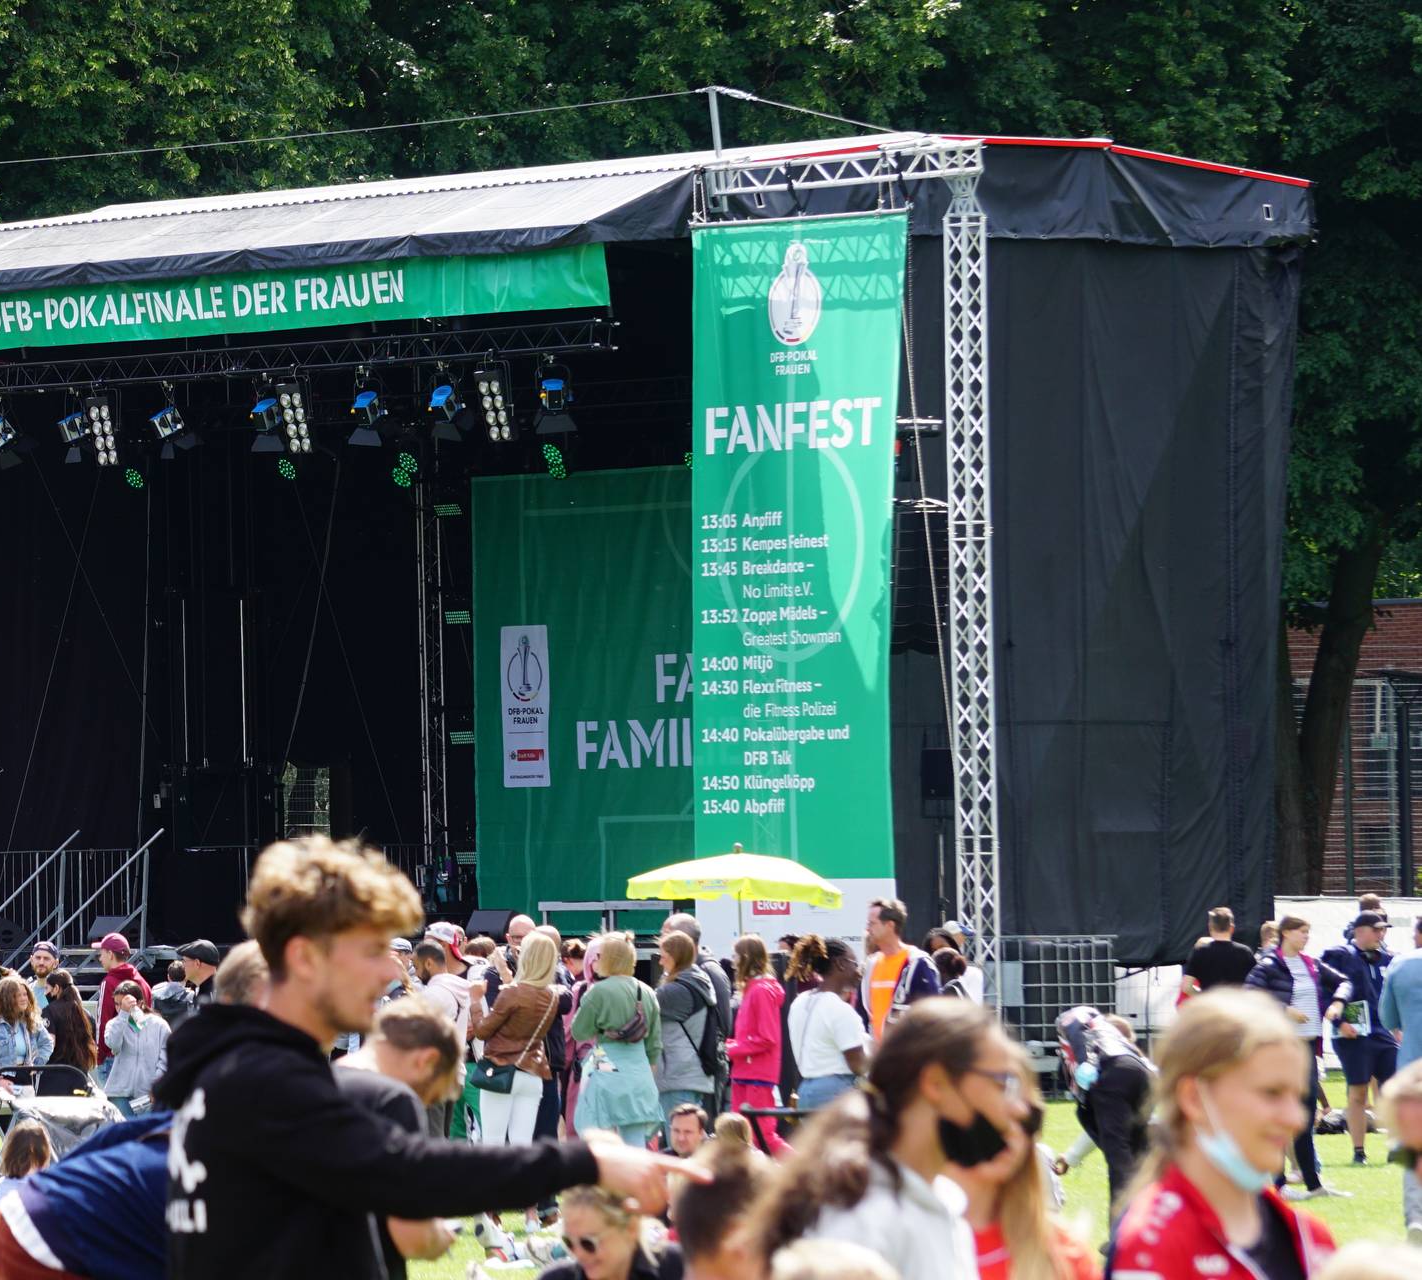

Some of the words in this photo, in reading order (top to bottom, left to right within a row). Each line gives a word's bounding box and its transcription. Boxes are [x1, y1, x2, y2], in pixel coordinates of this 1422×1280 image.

[232, 280, 288, 316] DER
[294, 269, 405, 312] FRAUEN
[770, 350, 819, 363] DFB-POKAL
[775, 364, 811, 376] FRAUEN
[705, 397, 882, 455] FANFEST
[701, 514, 737, 529] 13:05
[742, 511, 783, 530] Anpfiff
[701, 538, 737, 553] 13:15
[742, 536, 787, 553] Kempes
[788, 533, 829, 549] Feinest
[701, 561, 737, 577] 13:45
[742, 559, 805, 575] Breakdance
[742, 584, 761, 599] No
[764, 583, 793, 598] Limits
[701, 609, 738, 624] 13:52
[742, 607, 777, 626] Zoppe
[779, 605, 818, 621] Mädels
[742, 631, 787, 647] Greatest
[789, 629, 841, 645] Showman
[701, 656, 738, 672] 14:00
[742, 656, 774, 673] Miljö
[701, 680, 738, 696] 14:30
[508, 707, 544, 716] DFB-POKAL
[743, 704, 761, 719] die
[764, 702, 800, 718] Fitness
[802, 701, 837, 716] Polizei
[513, 716, 538, 725] FRAUEN
[701, 727, 739, 743] 14:40
[743, 726, 825, 745] Pokalübergabe
[827, 724, 850, 740] und
[744, 751, 768, 766] DFB
[771, 750, 792, 765] Talk
[702, 775, 740, 791] 14:50
[744, 774, 815, 794] Klüngelköpp
[702, 799, 739, 815] 15:40
[744, 798, 786, 817] Abpfiff
[757, 900, 787, 910] ERGO
